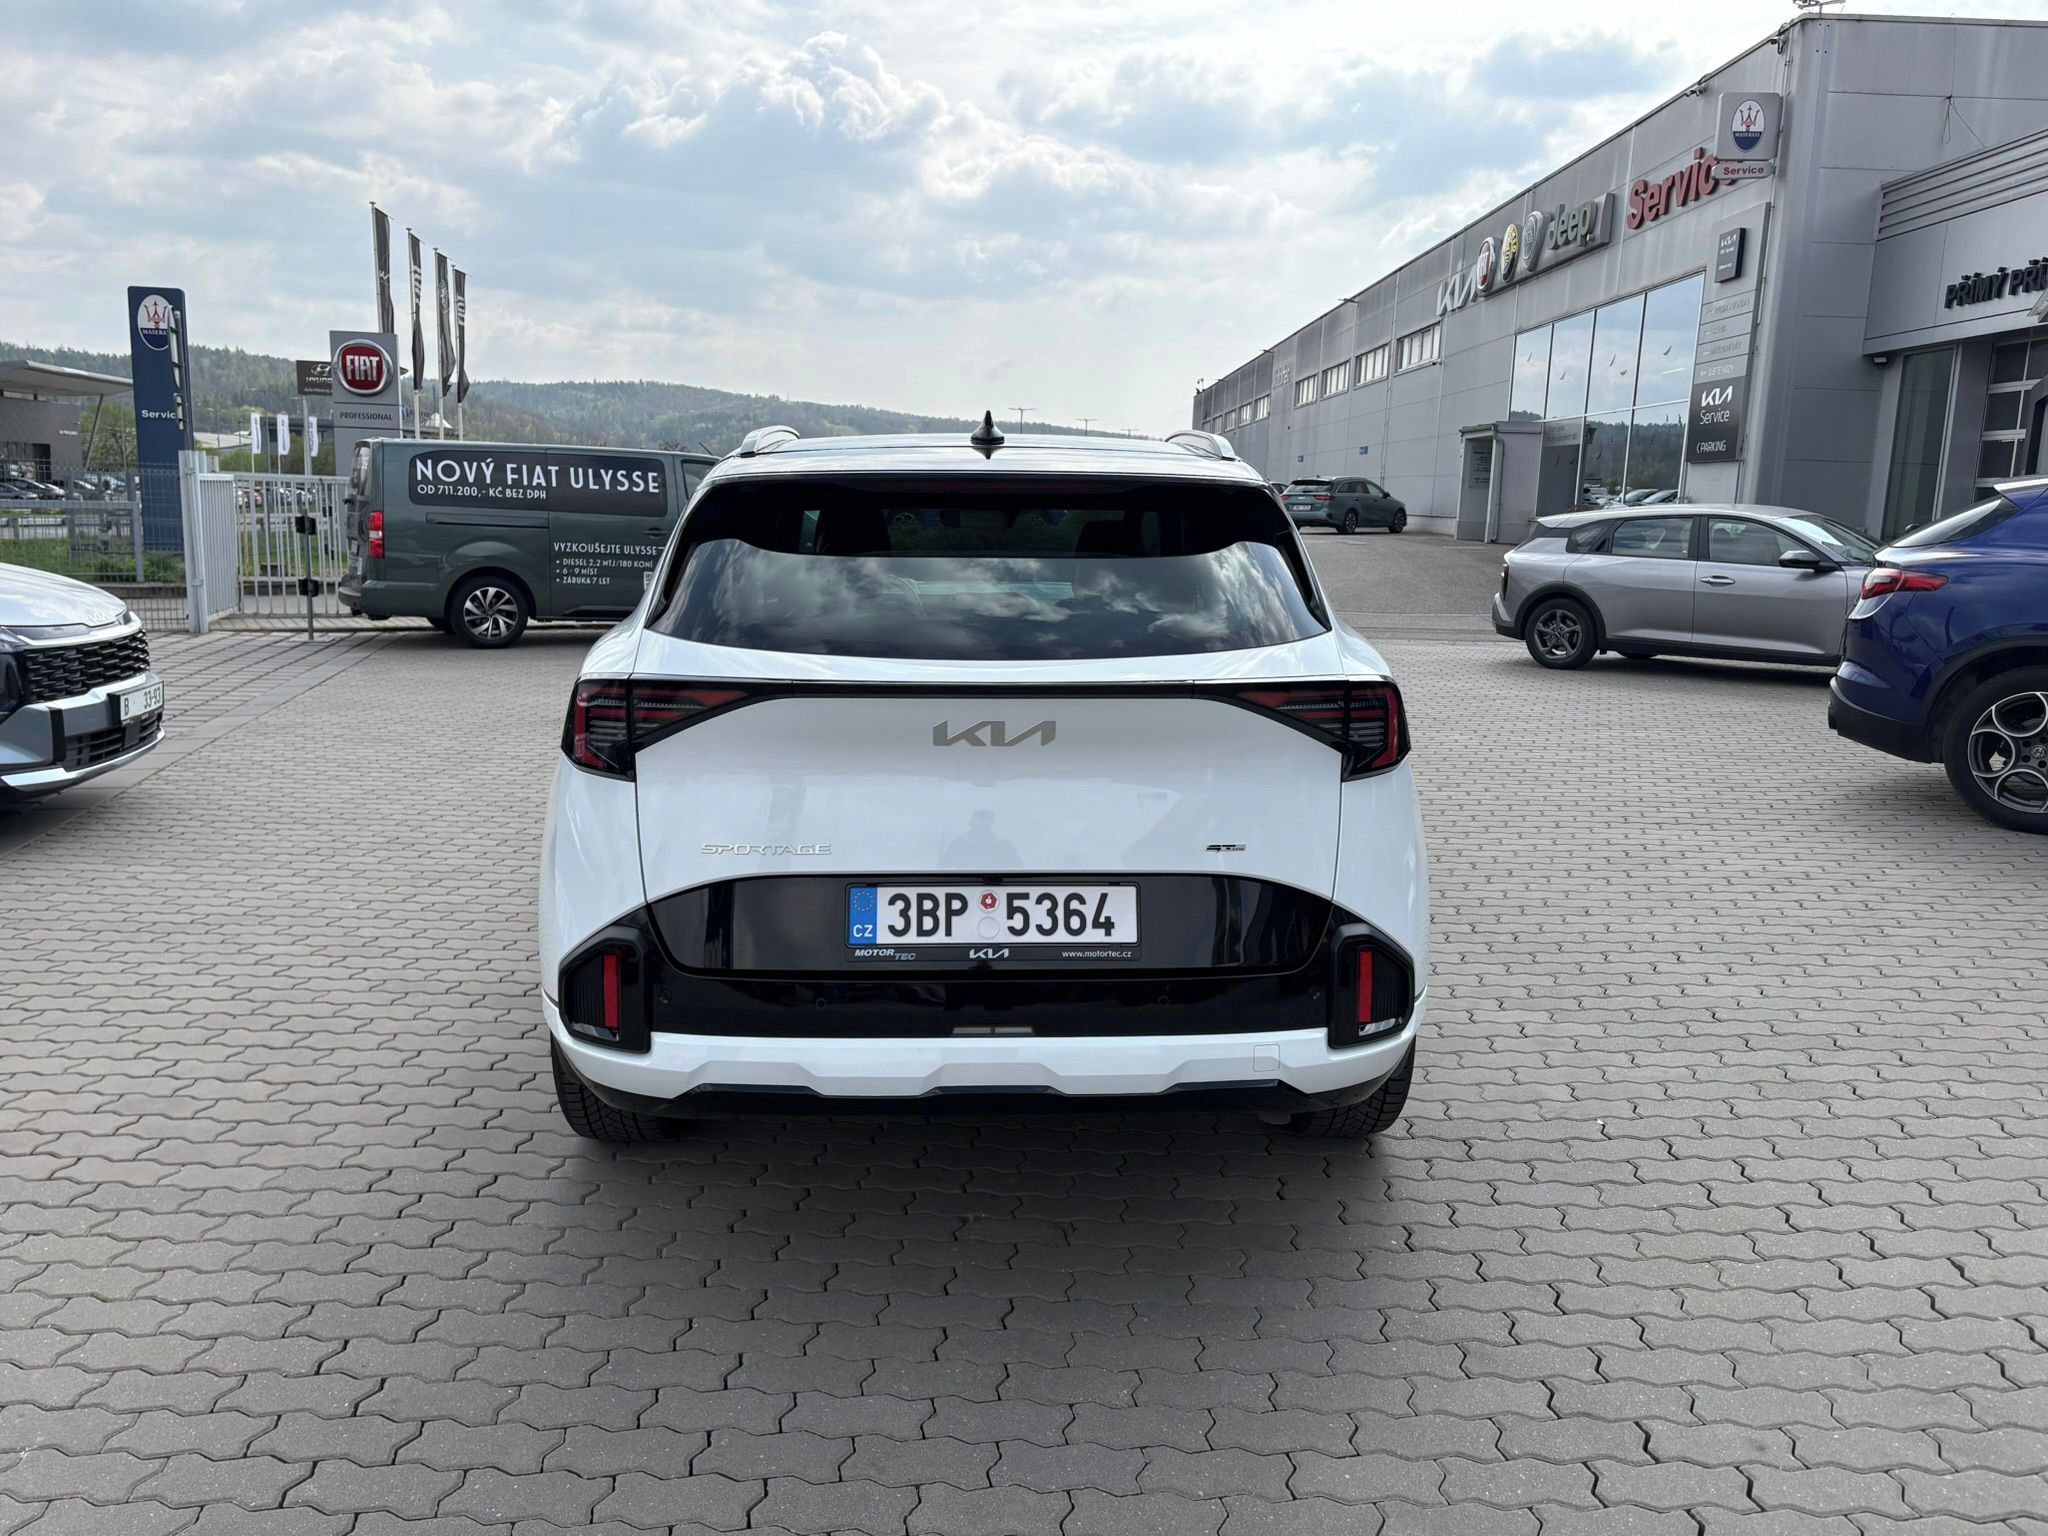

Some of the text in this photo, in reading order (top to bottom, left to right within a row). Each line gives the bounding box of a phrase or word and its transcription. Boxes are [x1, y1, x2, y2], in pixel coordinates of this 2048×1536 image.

[1723, 166, 1764, 176] Service
[1627, 147, 1739, 229] Servic
[1944, 256, 2048, 309] PŘÍMÝ PŘÍ
[346, 355, 379, 381] FIAT
[1701, 386, 1733, 407] KIA
[141, 409, 176, 419] Servic
[340, 411, 393, 421] PROFESSIONAL
[1700, 408, 1730, 425] Service
[1701, 440, 1726, 453] PARKING
[416, 458, 660, 493] NOVÝ FIAT ULYSSE
[417, 484, 435, 494] OD
[489, 486, 503, 497] KČ
[505, 489, 524, 499] BEZ
[527, 489, 547, 499] DPH
[554, 542, 657, 555] VYZKOUŠEJTE ULYSSE
[563, 558, 587, 566] DIESEL
[589, 558, 601, 567] 2,2
[581, 567, 598, 576] MÍST
[563, 575, 591, 584] ZÁRUKA
[933, 720, 1057, 746] KIA
[701, 843, 833, 855] SPORTAGE
[887, 892, 1115, 937] 3BP 5364
[853, 924, 873, 938] CZ
[854, 949, 916, 960] MOTOR TEC
[968, 948, 1009, 959] KIA
[1062, 950, 1132, 960] www.motortec.cz
